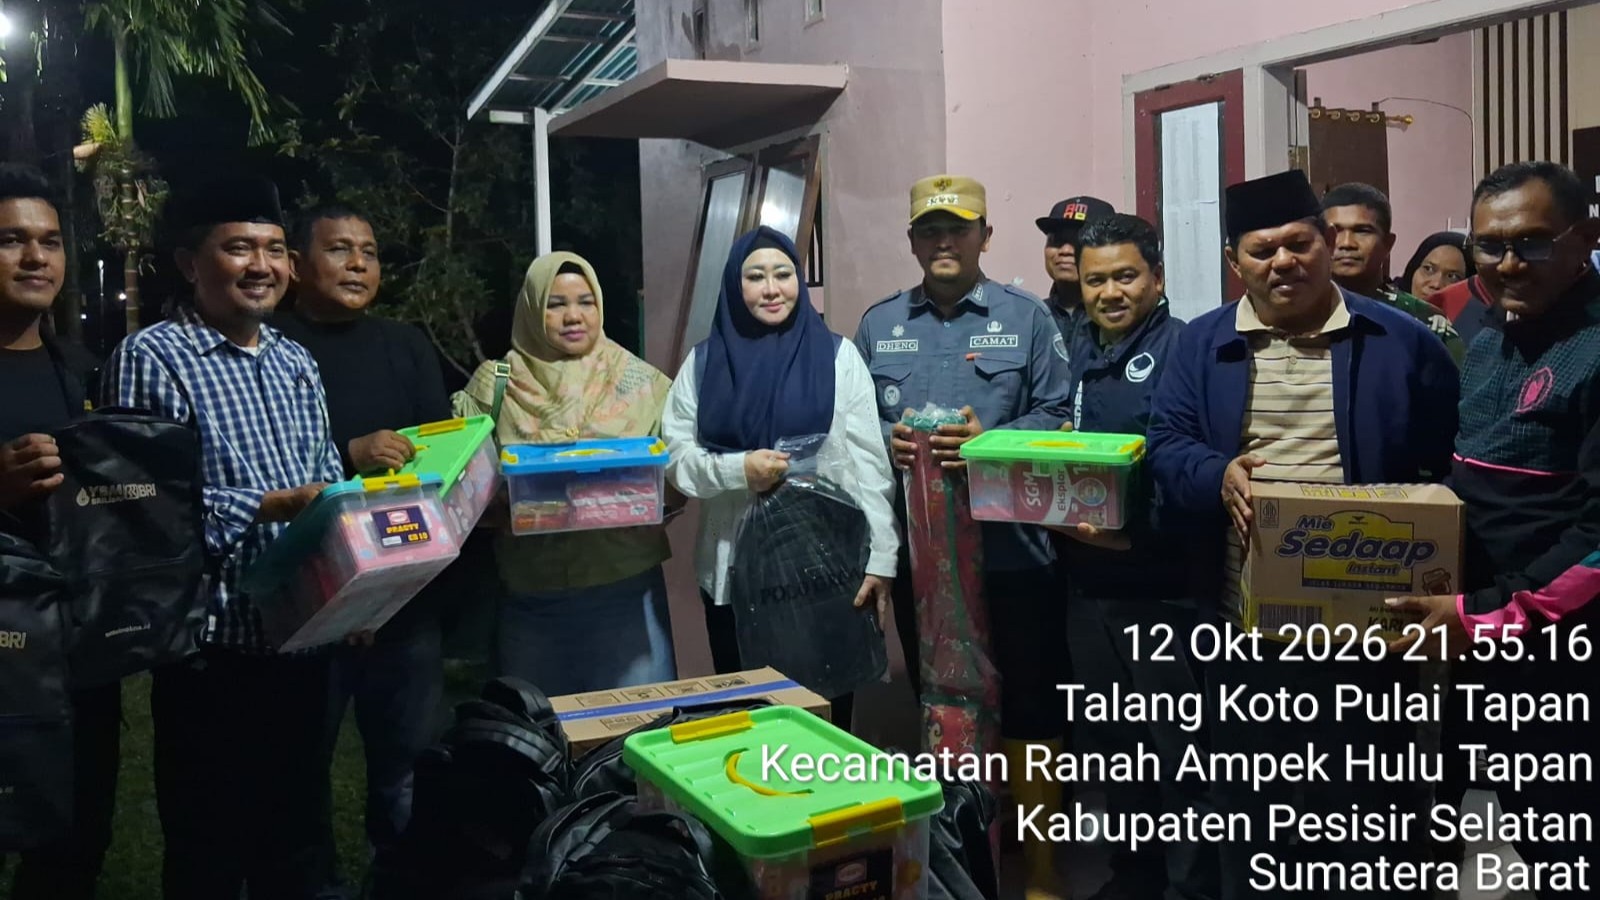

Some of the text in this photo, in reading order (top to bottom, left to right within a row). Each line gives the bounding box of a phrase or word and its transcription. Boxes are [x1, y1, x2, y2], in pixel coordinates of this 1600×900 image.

[973, 336, 1015, 346] CAMAT
[138, 482, 157, 498] BRI
[1022, 470, 1042, 507] SGM
[1299, 516, 1333, 531] Mie
[1278, 530, 1437, 567] Sedaap
